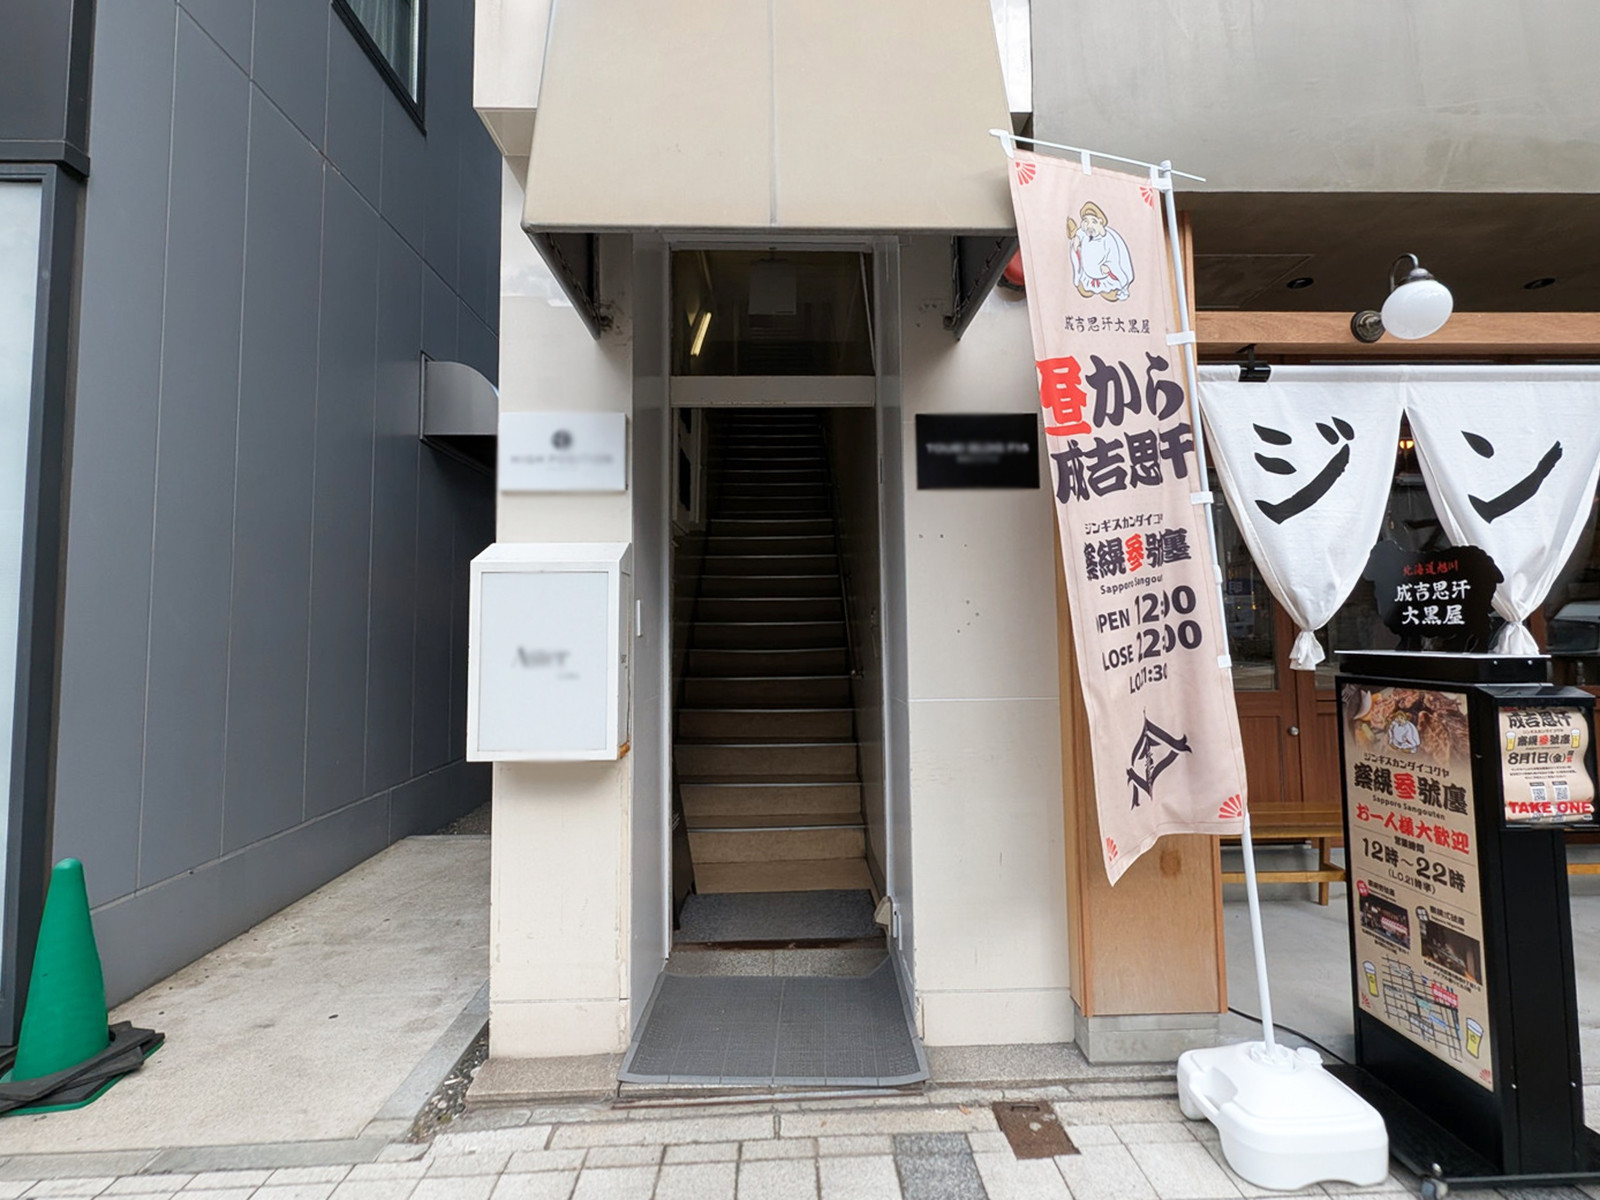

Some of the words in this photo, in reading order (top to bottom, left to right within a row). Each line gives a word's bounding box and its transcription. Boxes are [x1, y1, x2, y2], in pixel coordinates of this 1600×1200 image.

[1064, 314, 1151, 334] 成吉思汗大黒屋
[1036, 351, 1185, 436] 昼から
[1084, 513, 1163, 535] ジンギスカンダイコ
[1100, 580, 1134, 595] Sapporo
[1394, 579, 1471, 602] 成吉思汗
[1401, 604, 1465, 625] 大黒屋
[1102, 644, 1134, 671] LOSE
[1372, 794, 1402, 809] Sapporo
[1509, 801, 1552, 814] TAKE
[1557, 801, 1592, 814] ONE
